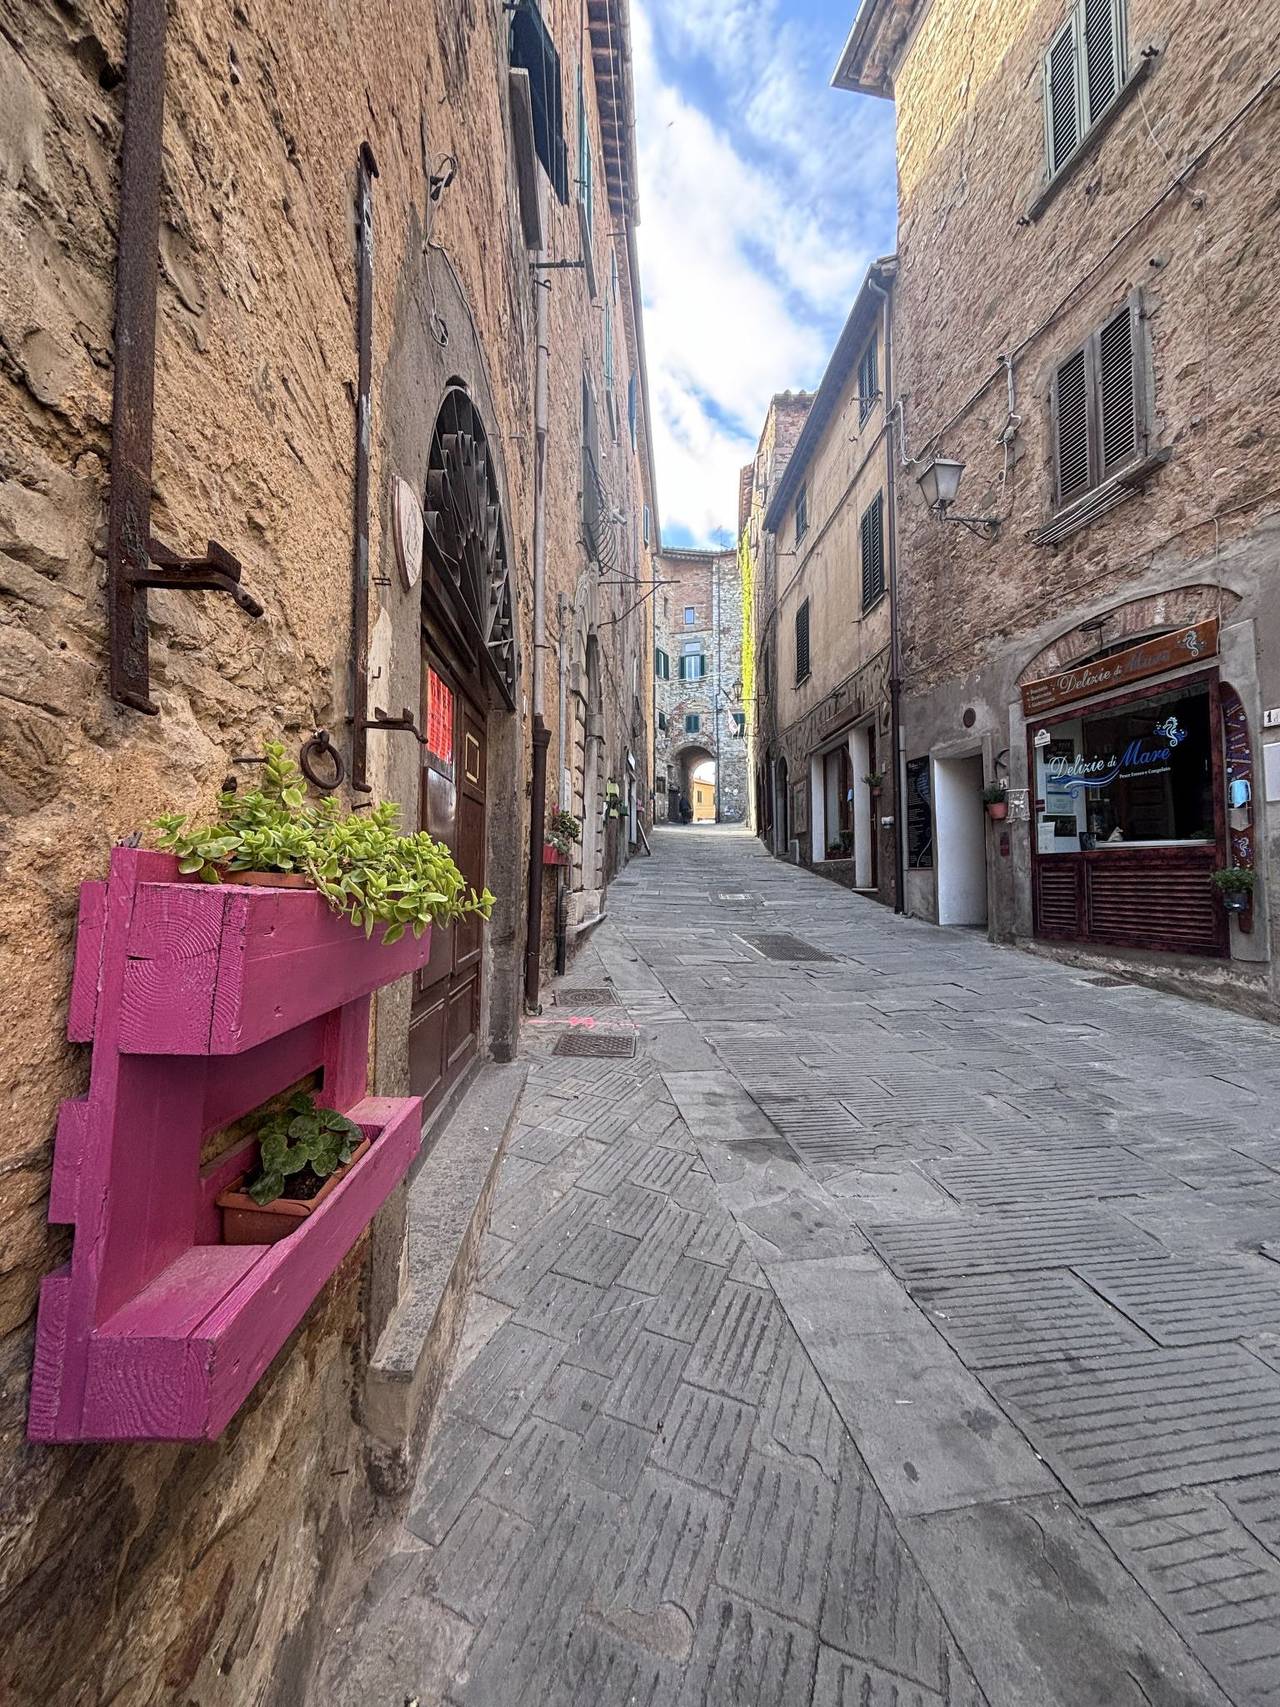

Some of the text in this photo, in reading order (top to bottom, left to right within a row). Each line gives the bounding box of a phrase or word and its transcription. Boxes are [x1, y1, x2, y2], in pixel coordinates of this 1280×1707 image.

[1057, 668, 1111, 695] Delizie
[1114, 665, 1122, 677] di
[1049, 740, 1171, 779] Delizie di Mare
